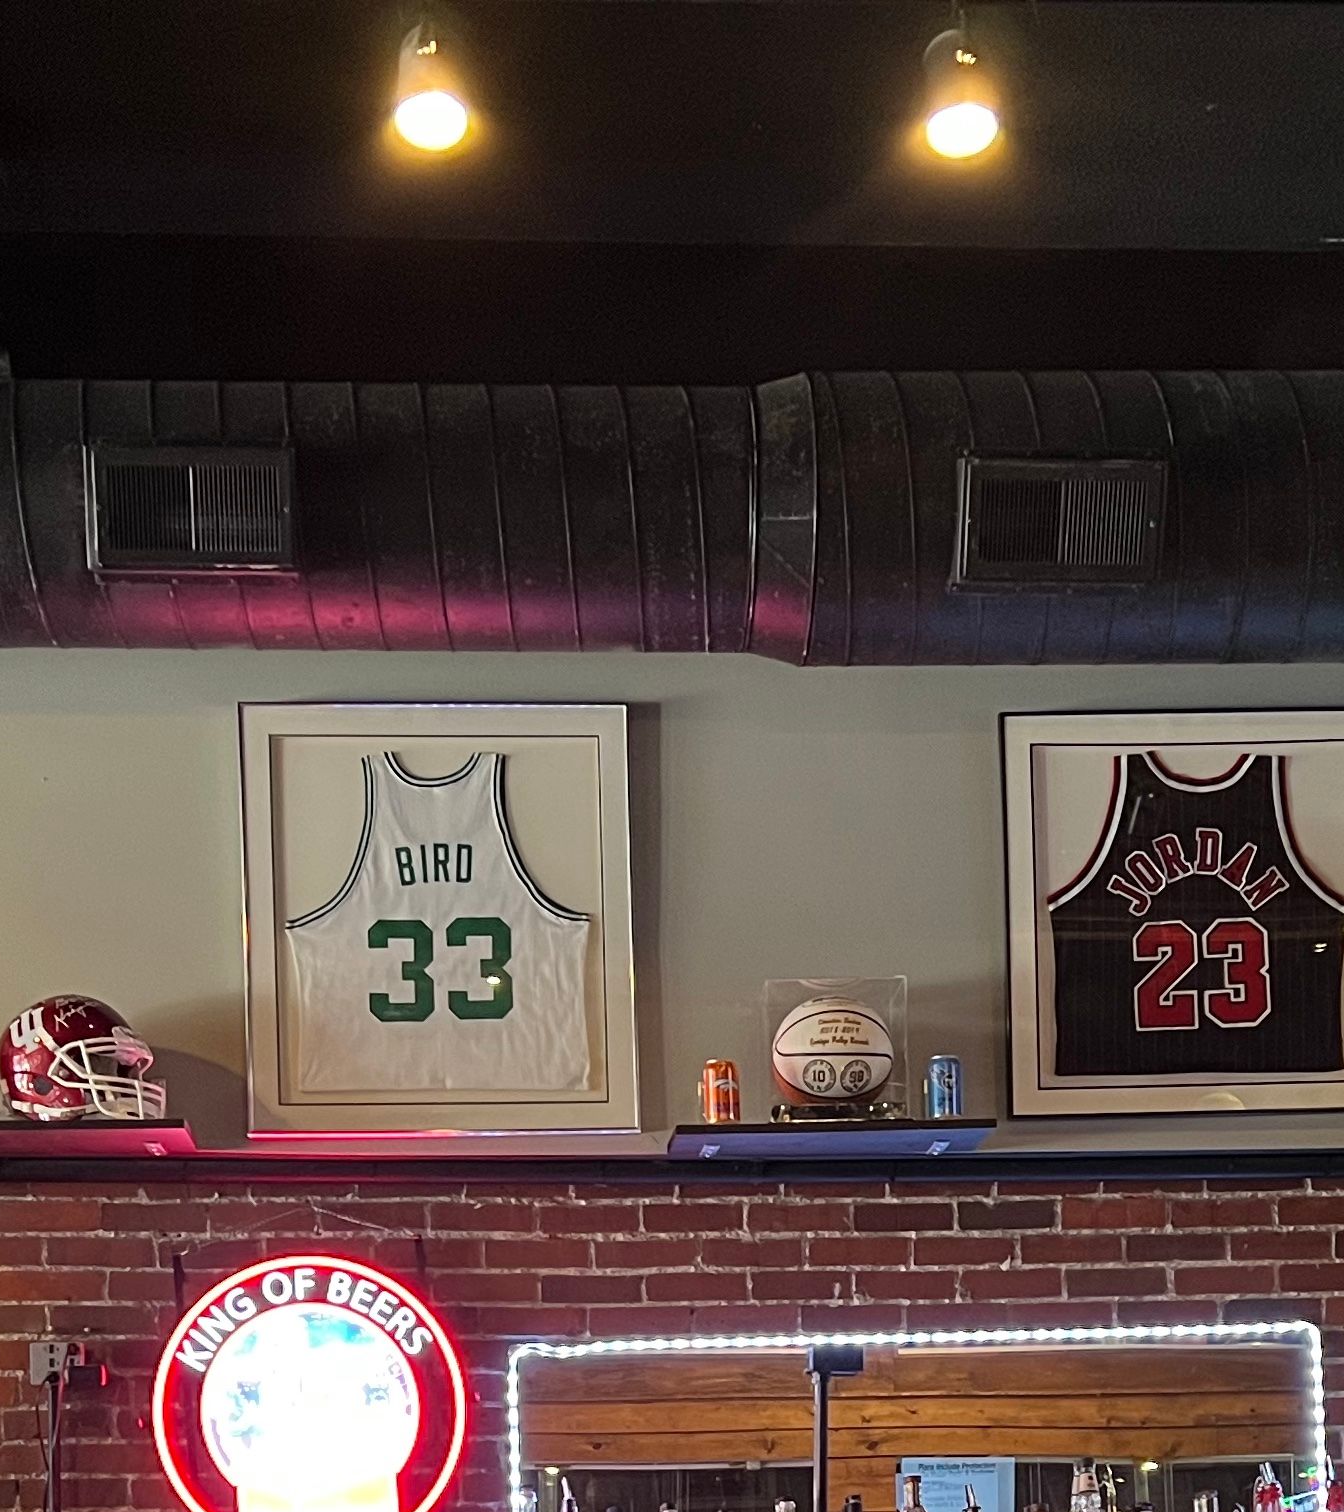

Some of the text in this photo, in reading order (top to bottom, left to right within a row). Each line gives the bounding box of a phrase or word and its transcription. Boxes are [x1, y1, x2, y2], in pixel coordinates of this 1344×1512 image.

[395, 843, 473, 886] BIRD
[1107, 828, 1289, 917] JORDAN
[367, 916, 514, 1023] 33
[1133, 917, 1271, 1032] 23
[175, 1268, 434, 1372] KING OF BEERS
